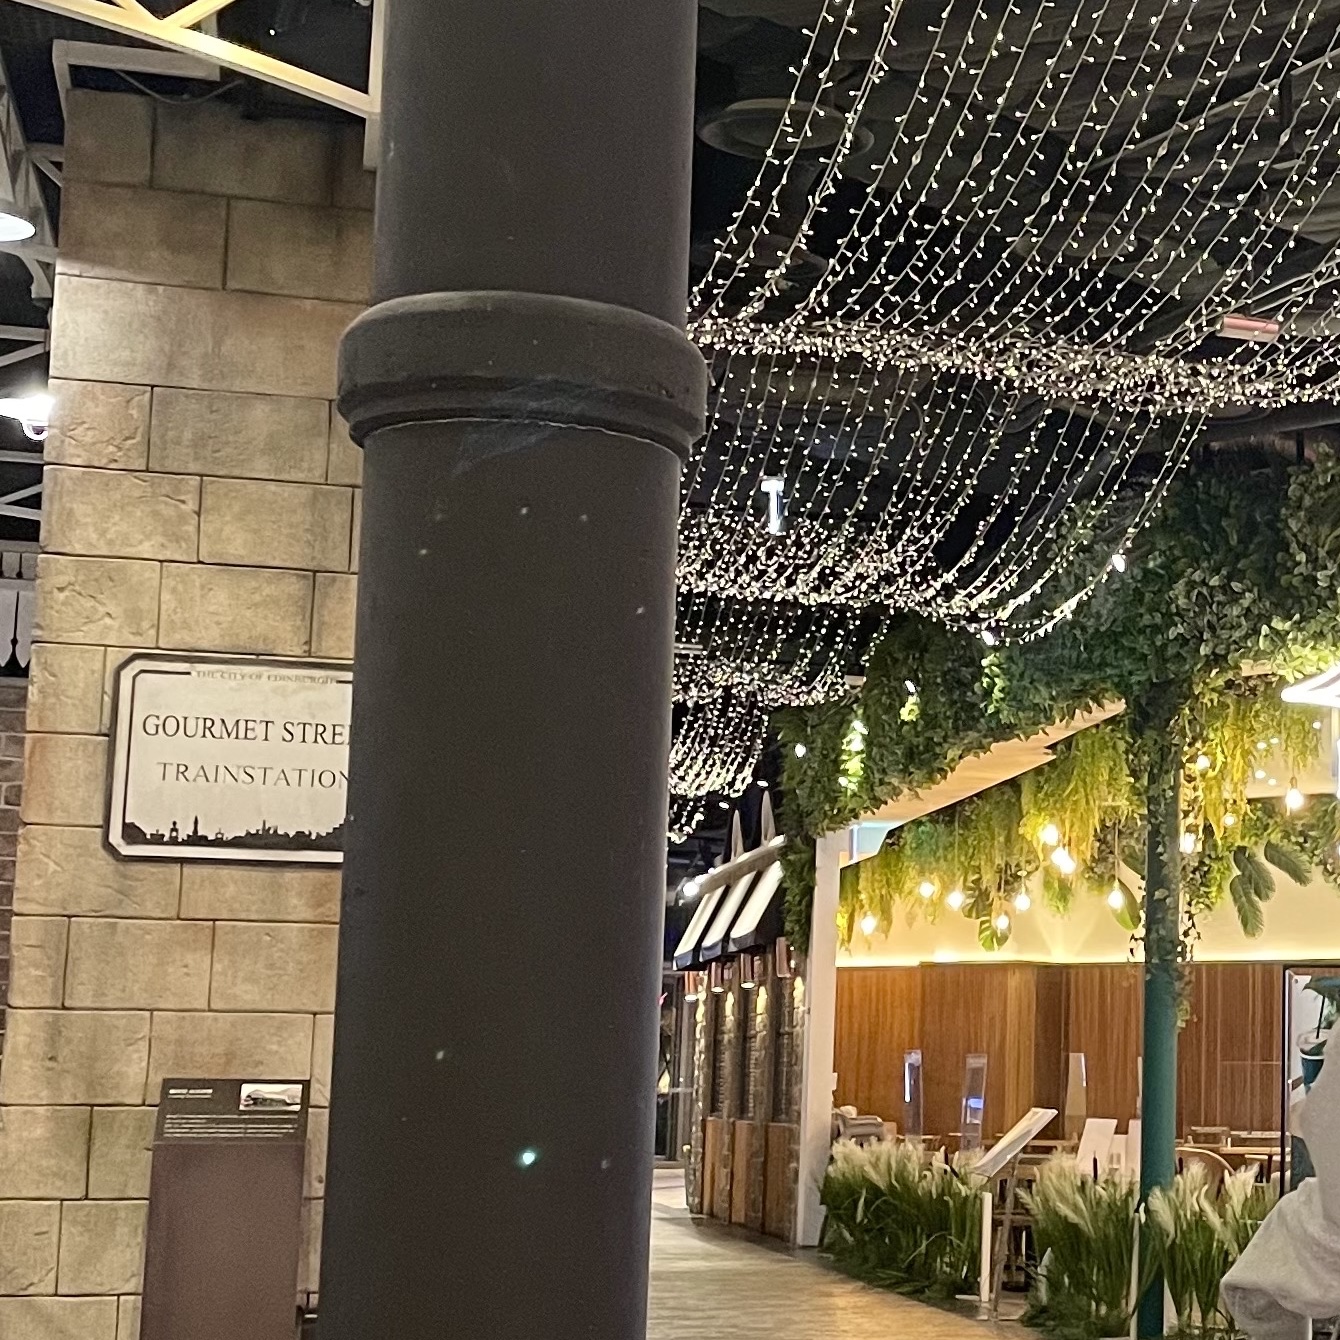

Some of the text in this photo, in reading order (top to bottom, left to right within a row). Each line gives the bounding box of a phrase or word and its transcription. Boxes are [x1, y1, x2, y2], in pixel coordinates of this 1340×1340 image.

[219, 671, 247, 681] CITY
[249, 672, 264, 681] OF
[142, 713, 352, 745] GOURMET STRE
